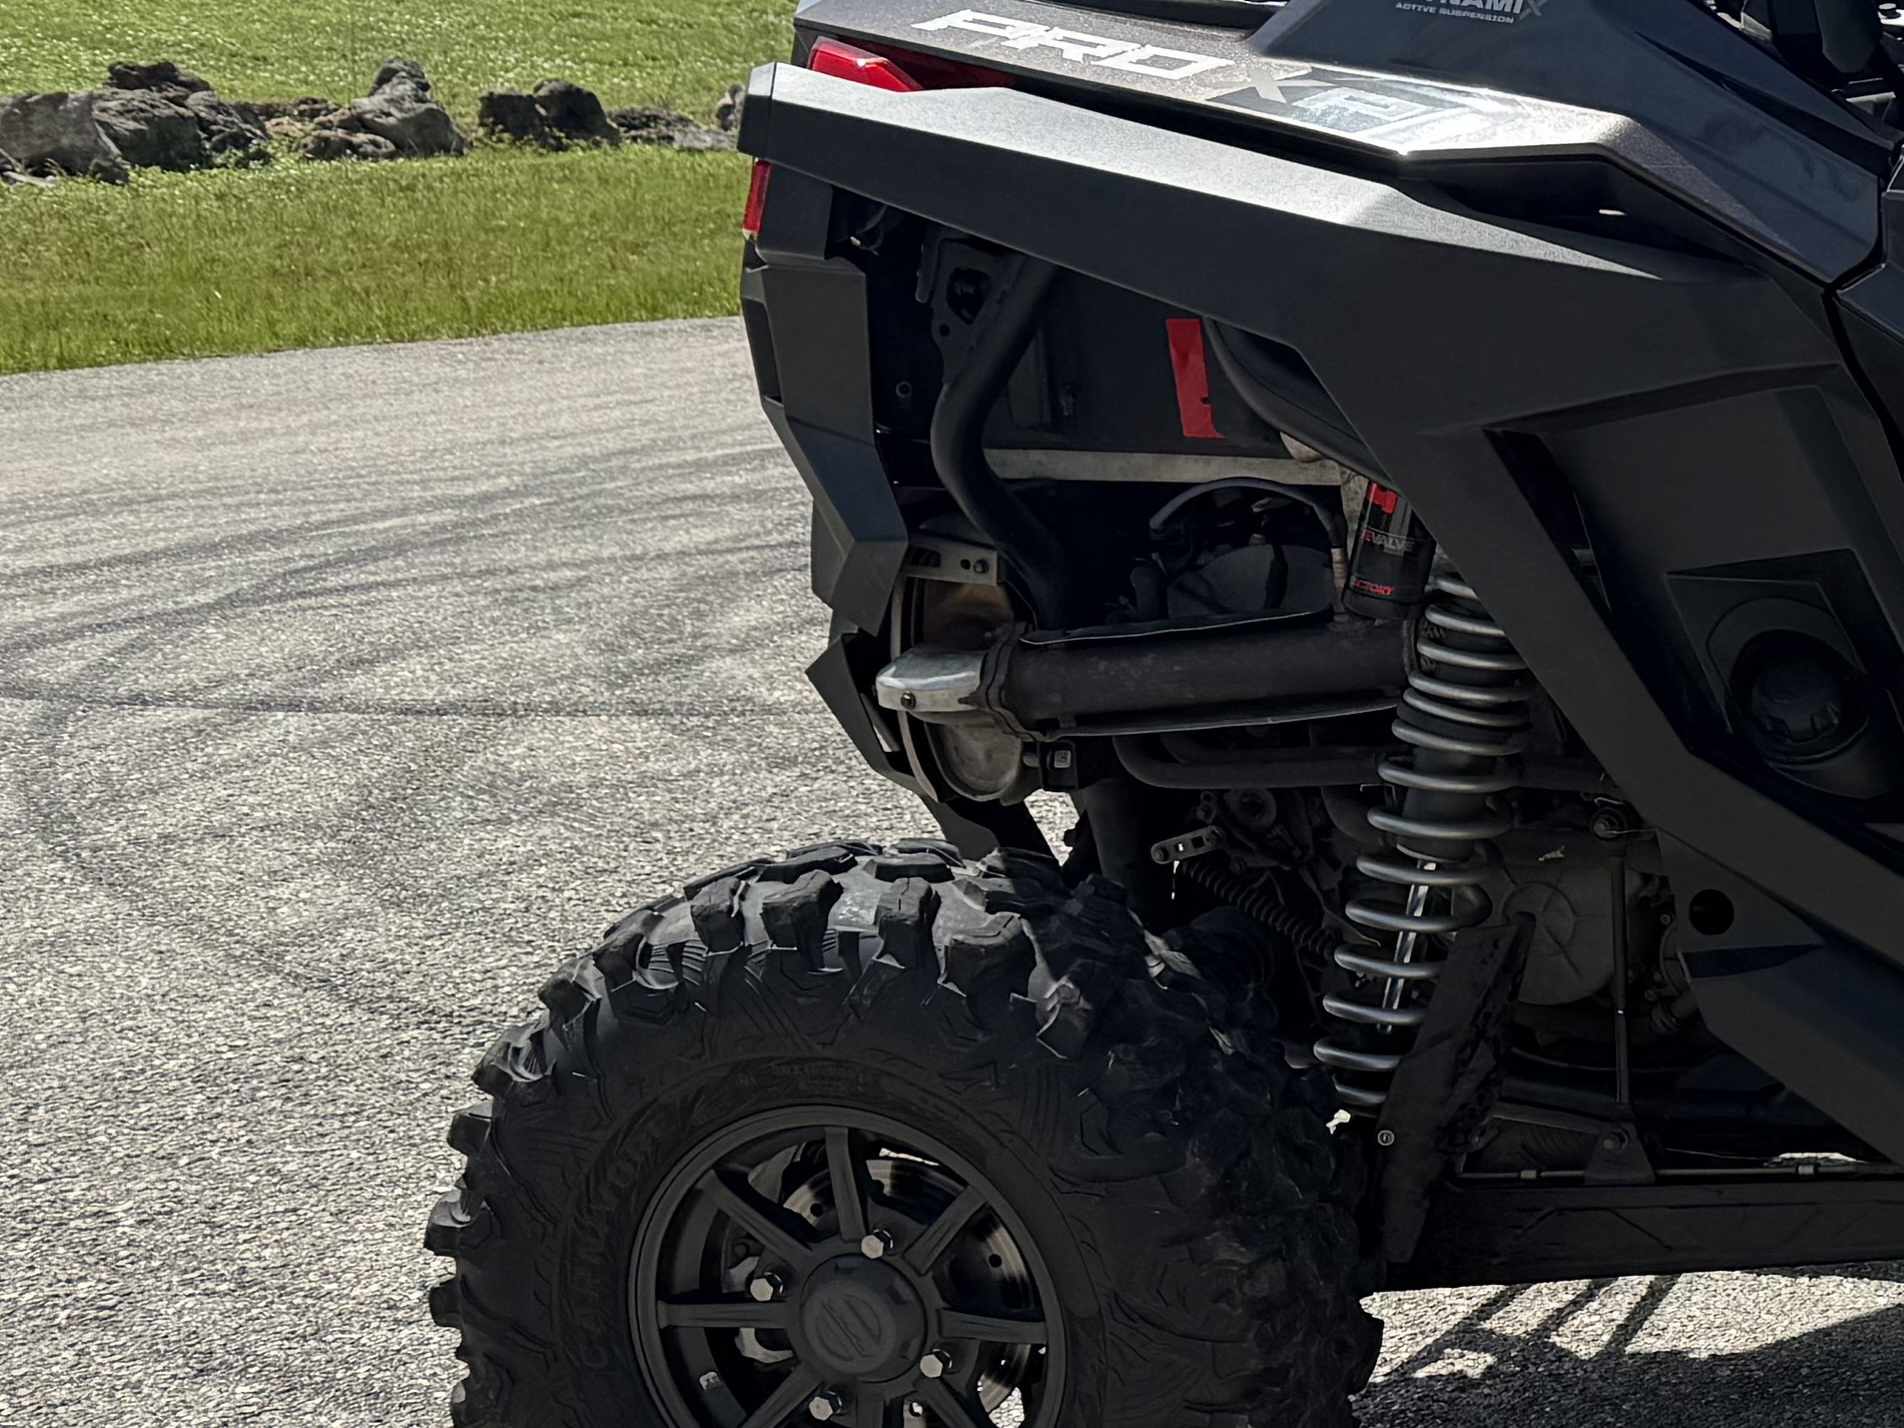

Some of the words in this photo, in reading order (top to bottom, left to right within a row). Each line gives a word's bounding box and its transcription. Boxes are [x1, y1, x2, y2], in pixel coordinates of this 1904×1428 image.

[1395, 2, 1436, 15] ACTIVE
[1438, 9, 1514, 24] SUSPENSION
[911, 9, 1235, 80] PRO
